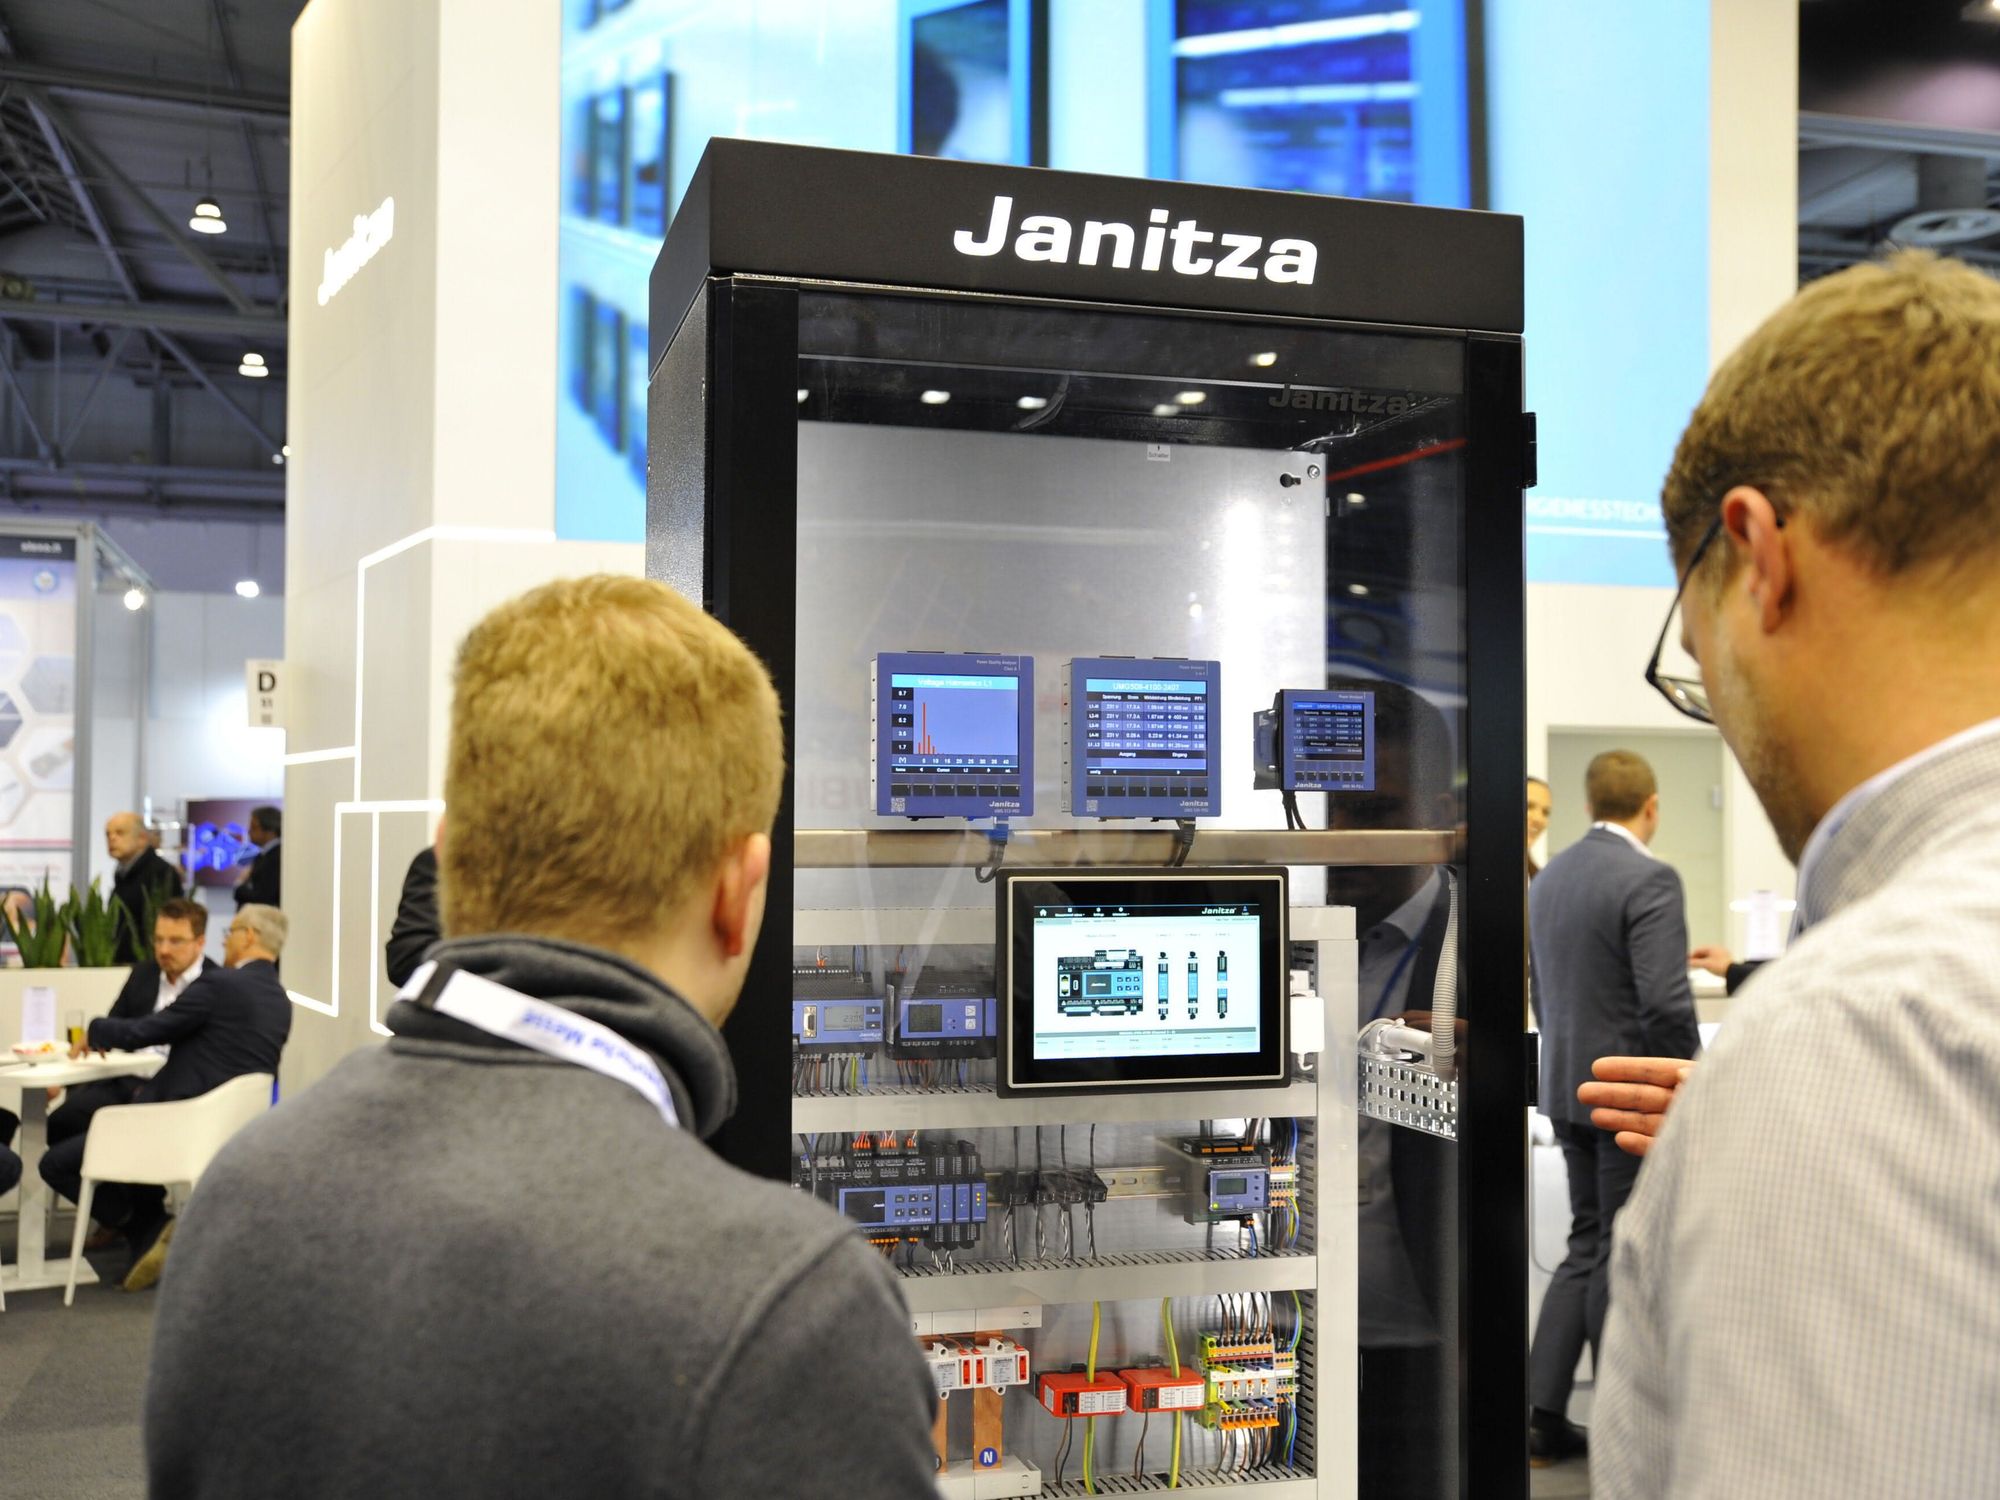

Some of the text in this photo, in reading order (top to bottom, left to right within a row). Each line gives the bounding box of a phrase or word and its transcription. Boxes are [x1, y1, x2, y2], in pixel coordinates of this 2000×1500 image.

[953, 195, 1318, 285] Janitza
[257, 671, 276, 692] D
[918, 678, 945, 688] Voltage
[989, 800, 1020, 808] Janitza
[1201, 906, 1237, 915] Janitza
[983, 1451, 993, 1463] N
